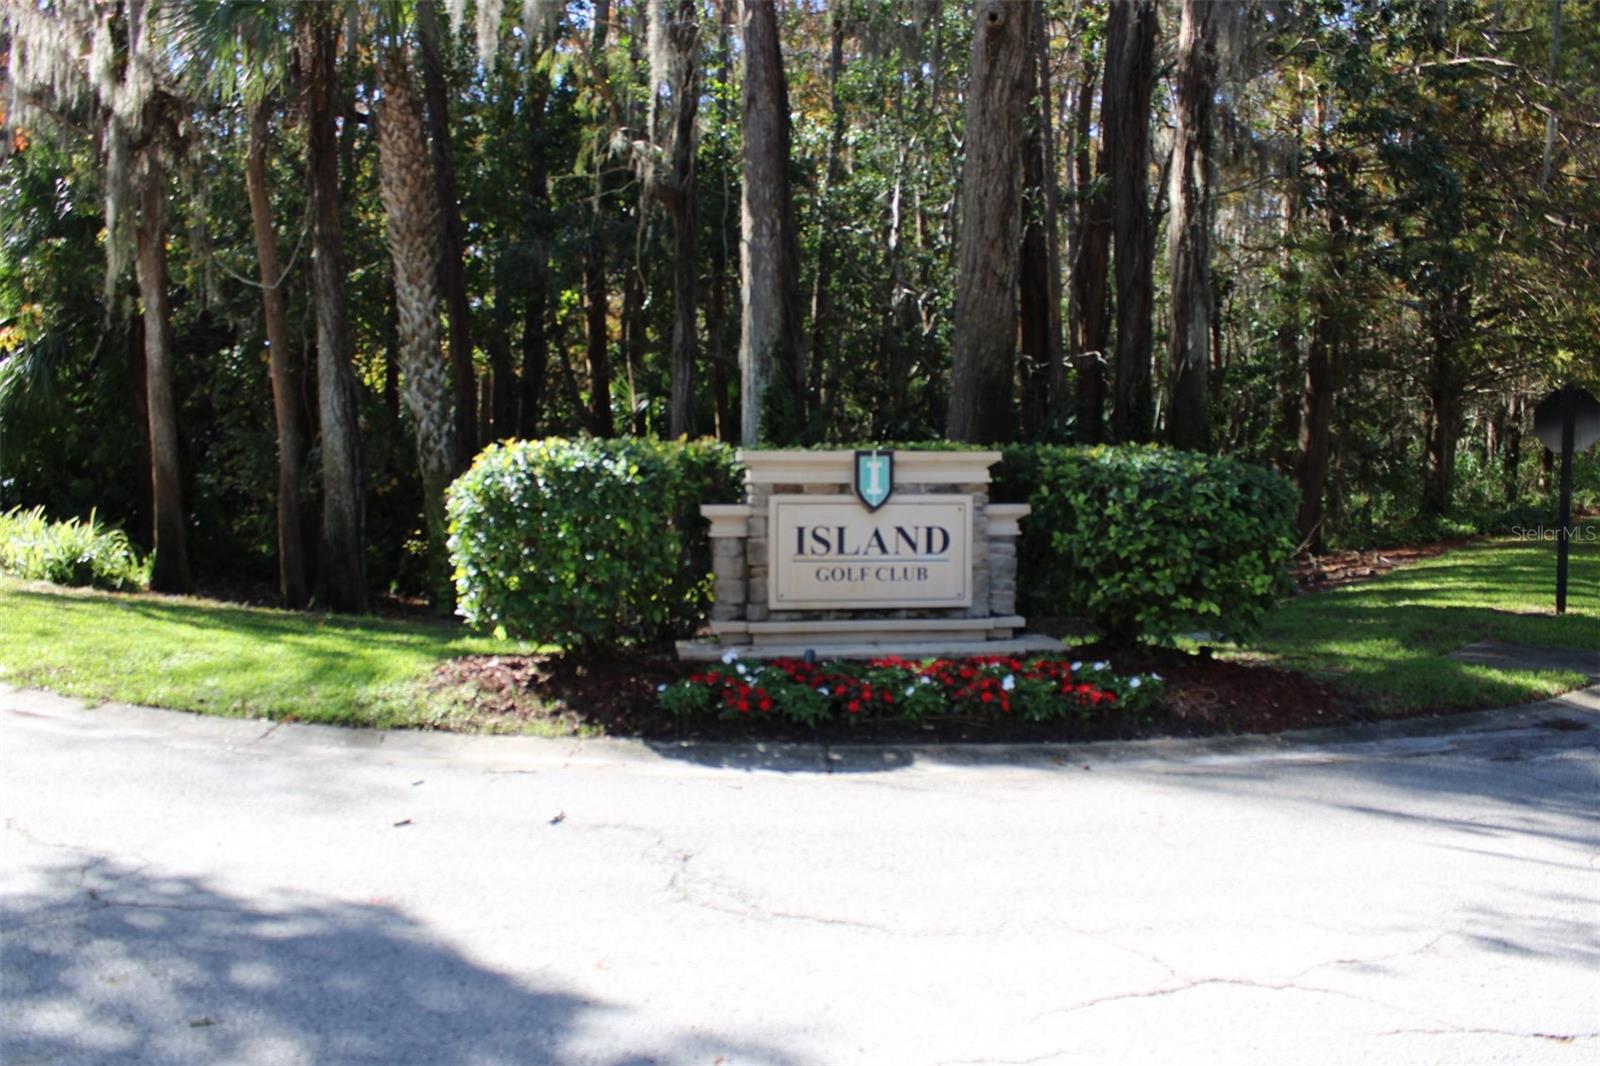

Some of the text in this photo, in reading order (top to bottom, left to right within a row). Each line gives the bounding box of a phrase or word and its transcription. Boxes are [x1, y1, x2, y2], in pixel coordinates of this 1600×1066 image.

[794, 525, 950, 557] ISLAND
[815, 566, 928, 582] GOLF CLUB
